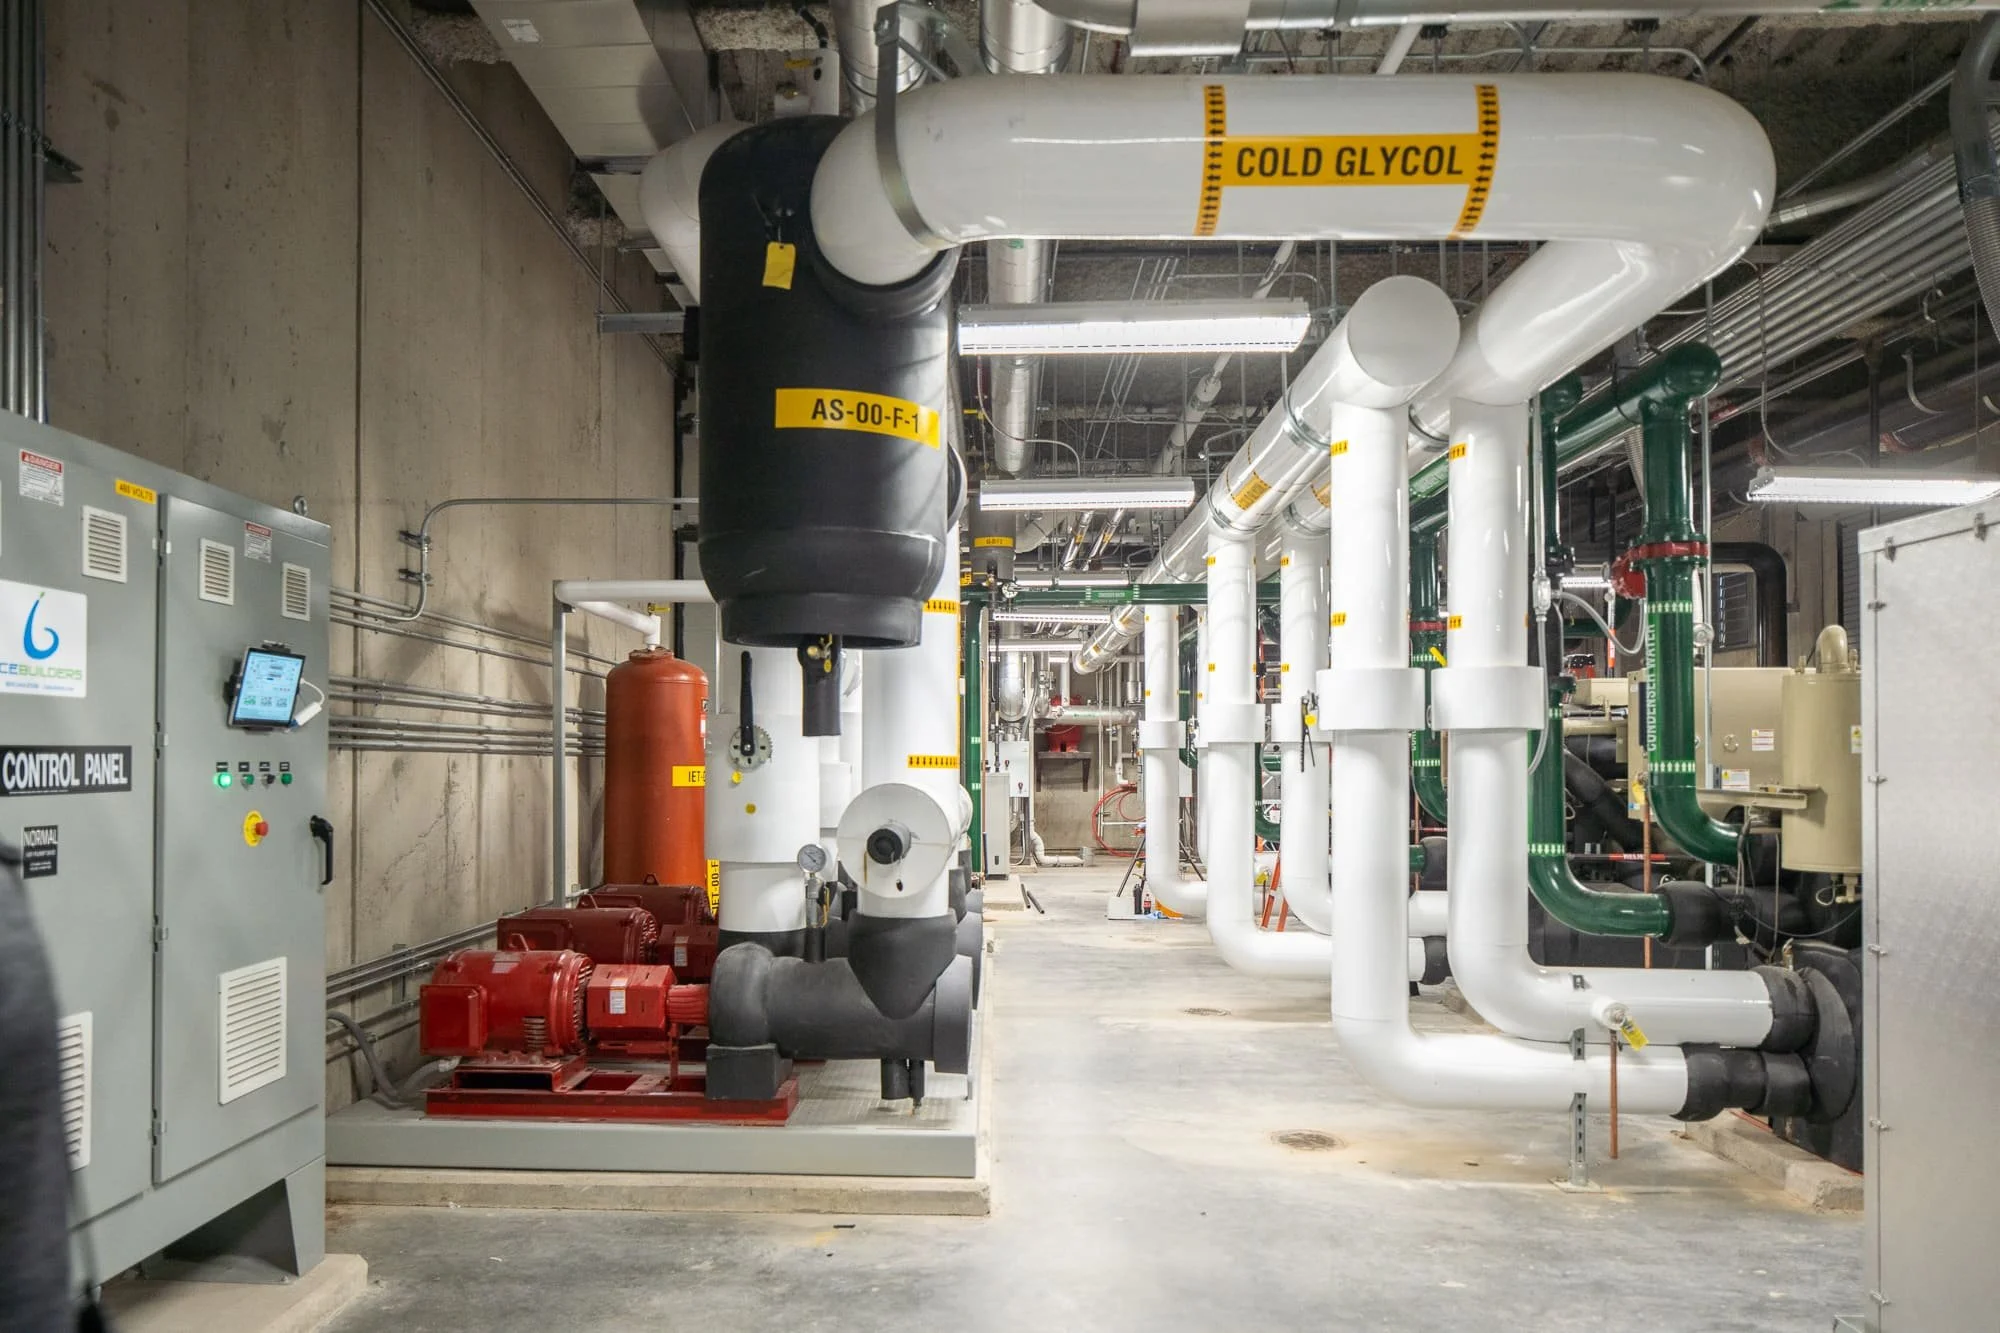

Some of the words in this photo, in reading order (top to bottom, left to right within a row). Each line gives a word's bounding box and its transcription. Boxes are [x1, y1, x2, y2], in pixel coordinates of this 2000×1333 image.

[1236, 147, 1323, 177] COLD
[1335, 145, 1463, 176] GLYCOL
[811, 398, 918, 434] AS-00-F-1
[132, 486, 153, 502] VOLTS
[1647, 624, 1656, 668] WATER
[1647, 674, 1656, 752] CONDENSER
[2, 751, 80, 790] CONTROL
[84, 753, 128, 785] PANEL
[24, 829, 58, 848] NORMAL
